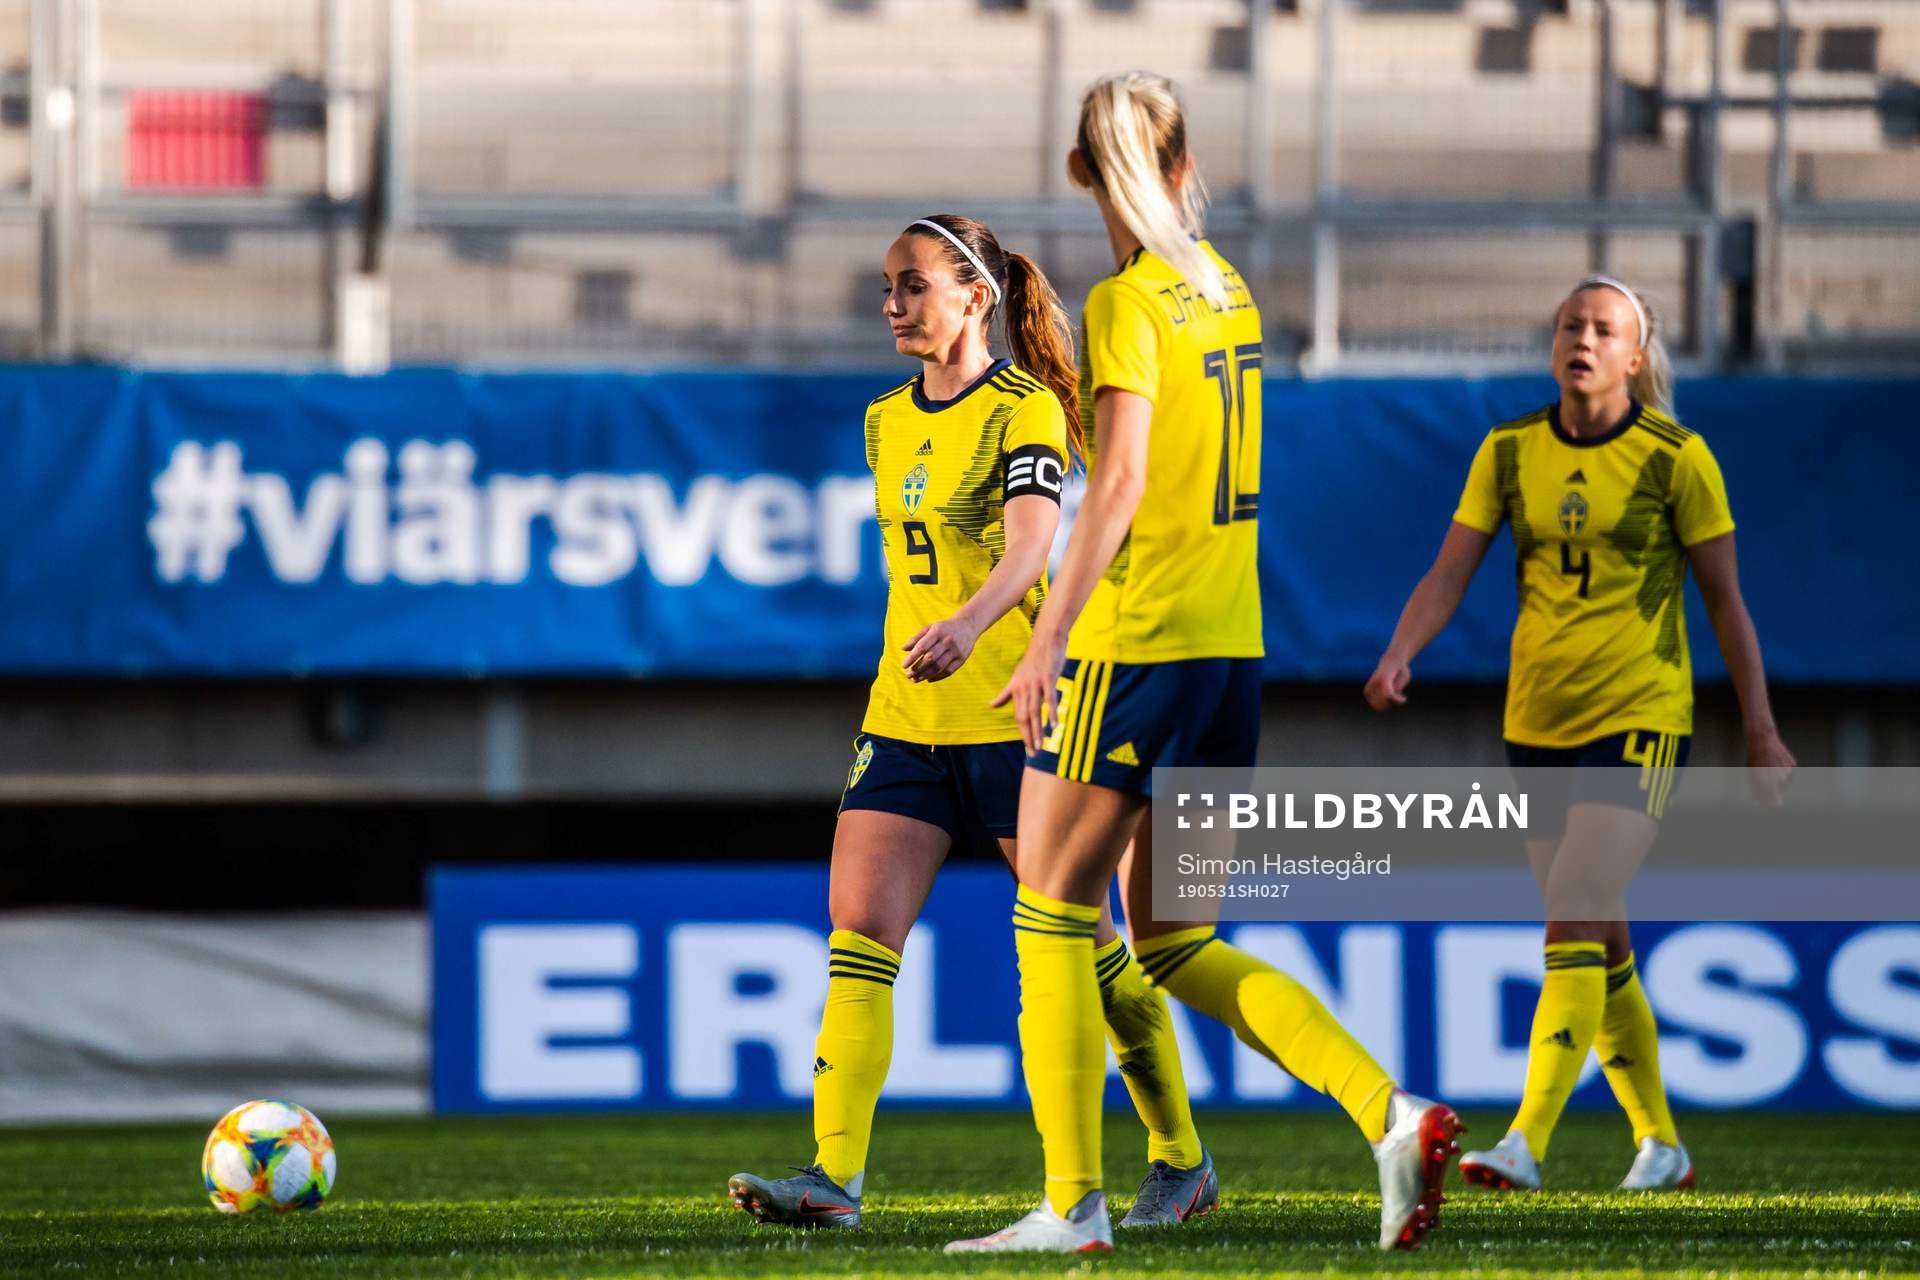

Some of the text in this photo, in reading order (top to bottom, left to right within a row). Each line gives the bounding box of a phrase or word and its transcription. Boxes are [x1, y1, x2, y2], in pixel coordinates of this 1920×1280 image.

[148, 437, 892, 587] #viärsver
[903, 521, 938, 584] 9
[1561, 543, 1589, 598] 4
[1623, 731, 1655, 790] 4
